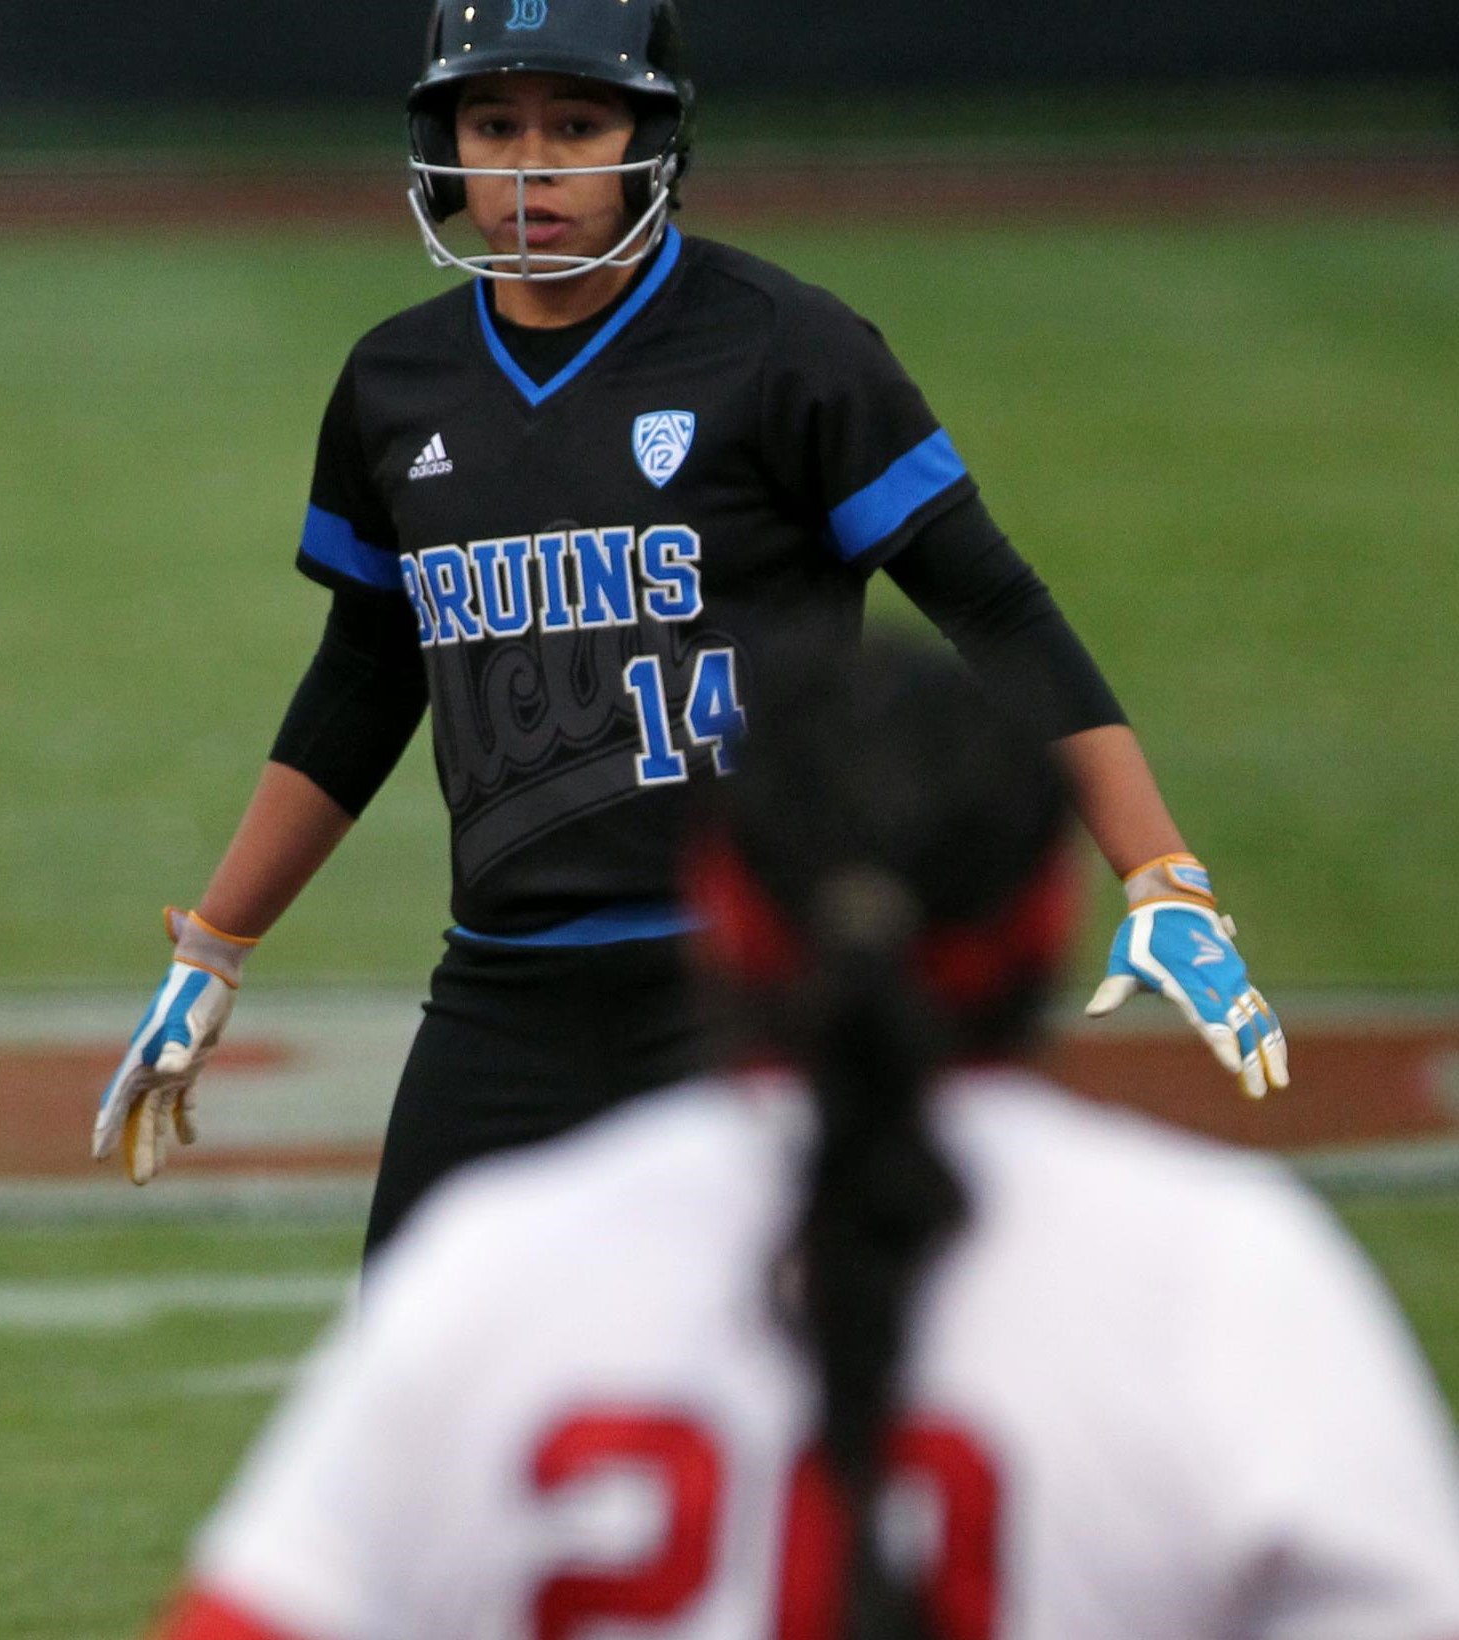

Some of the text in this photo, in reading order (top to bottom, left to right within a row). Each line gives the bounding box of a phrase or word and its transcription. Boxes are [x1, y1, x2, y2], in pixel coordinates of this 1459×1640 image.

[637, 413, 693, 460] PAC
[408, 459, 453, 480] adidas
[650, 449, 673, 470] 12
[623, 646, 747, 787] 14
